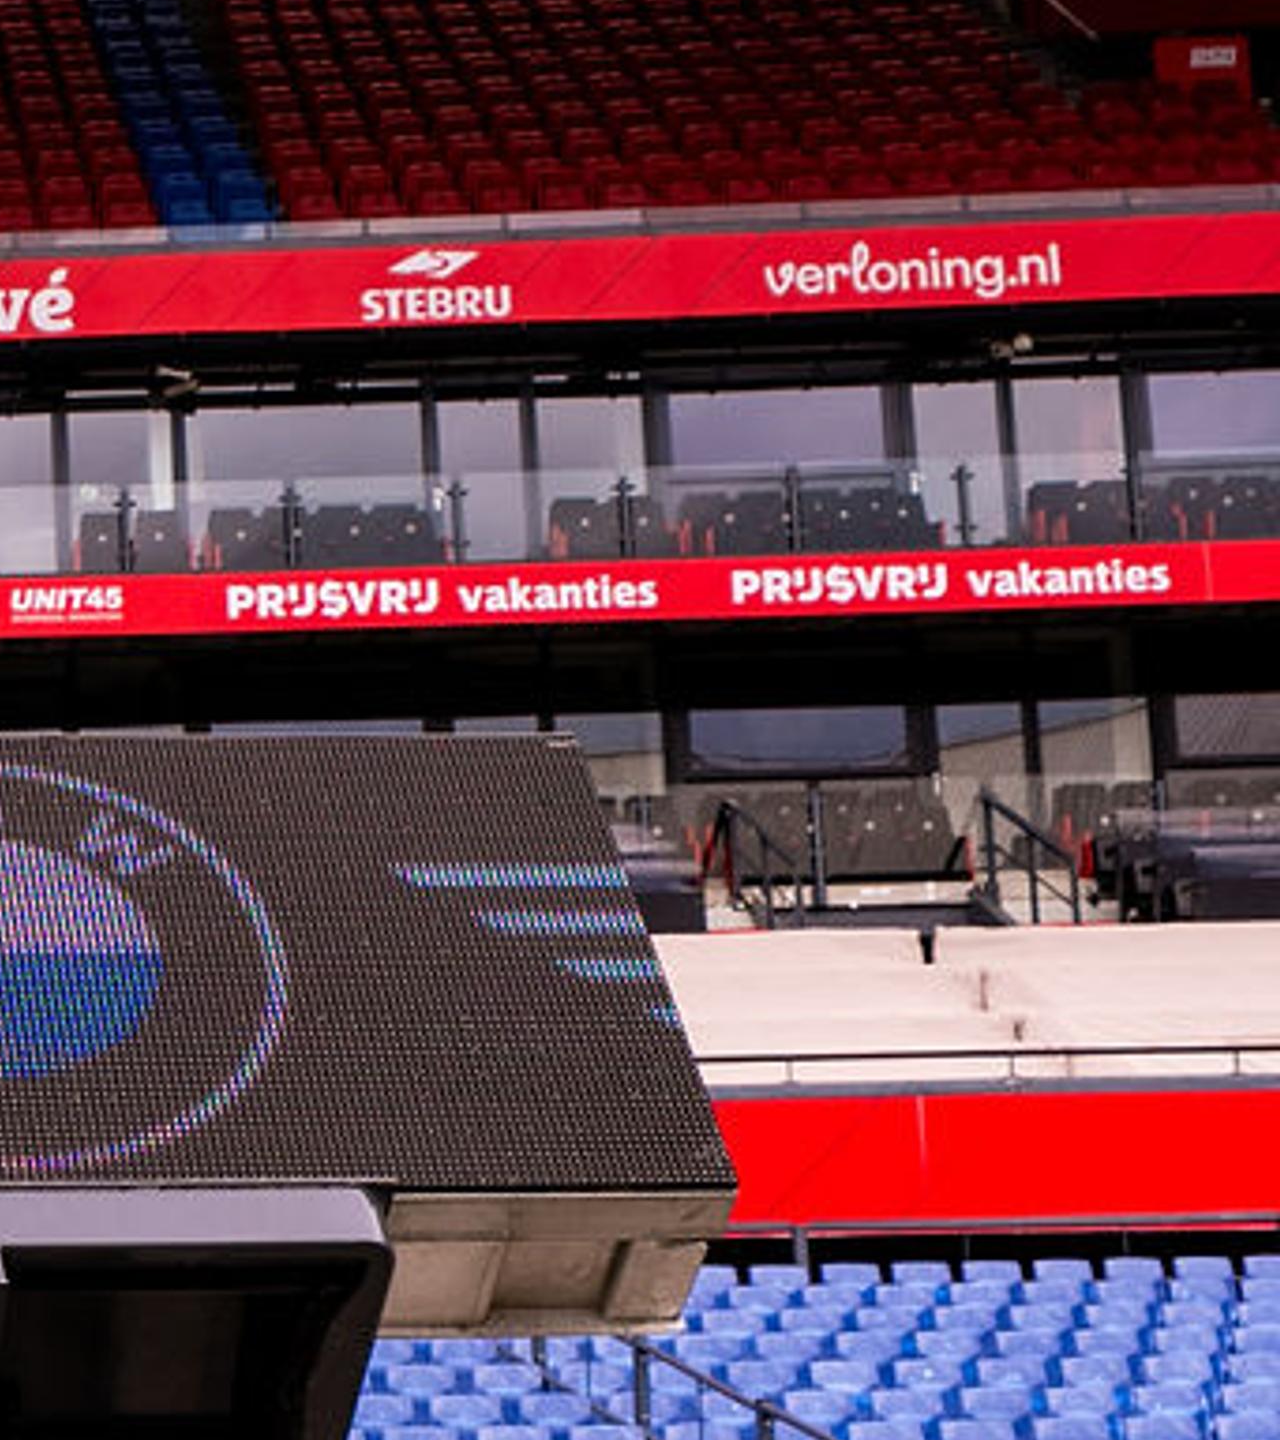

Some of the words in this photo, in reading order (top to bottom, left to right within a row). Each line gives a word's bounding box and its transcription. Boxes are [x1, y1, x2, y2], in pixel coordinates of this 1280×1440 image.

[764, 241, 1061, 299] verloning.nl
[362, 286, 512, 322] STEBRU
[457, 574, 659, 613] vakanties
[966, 558, 1171, 597] vakanties
[10, 586, 124, 611] UNIT45
